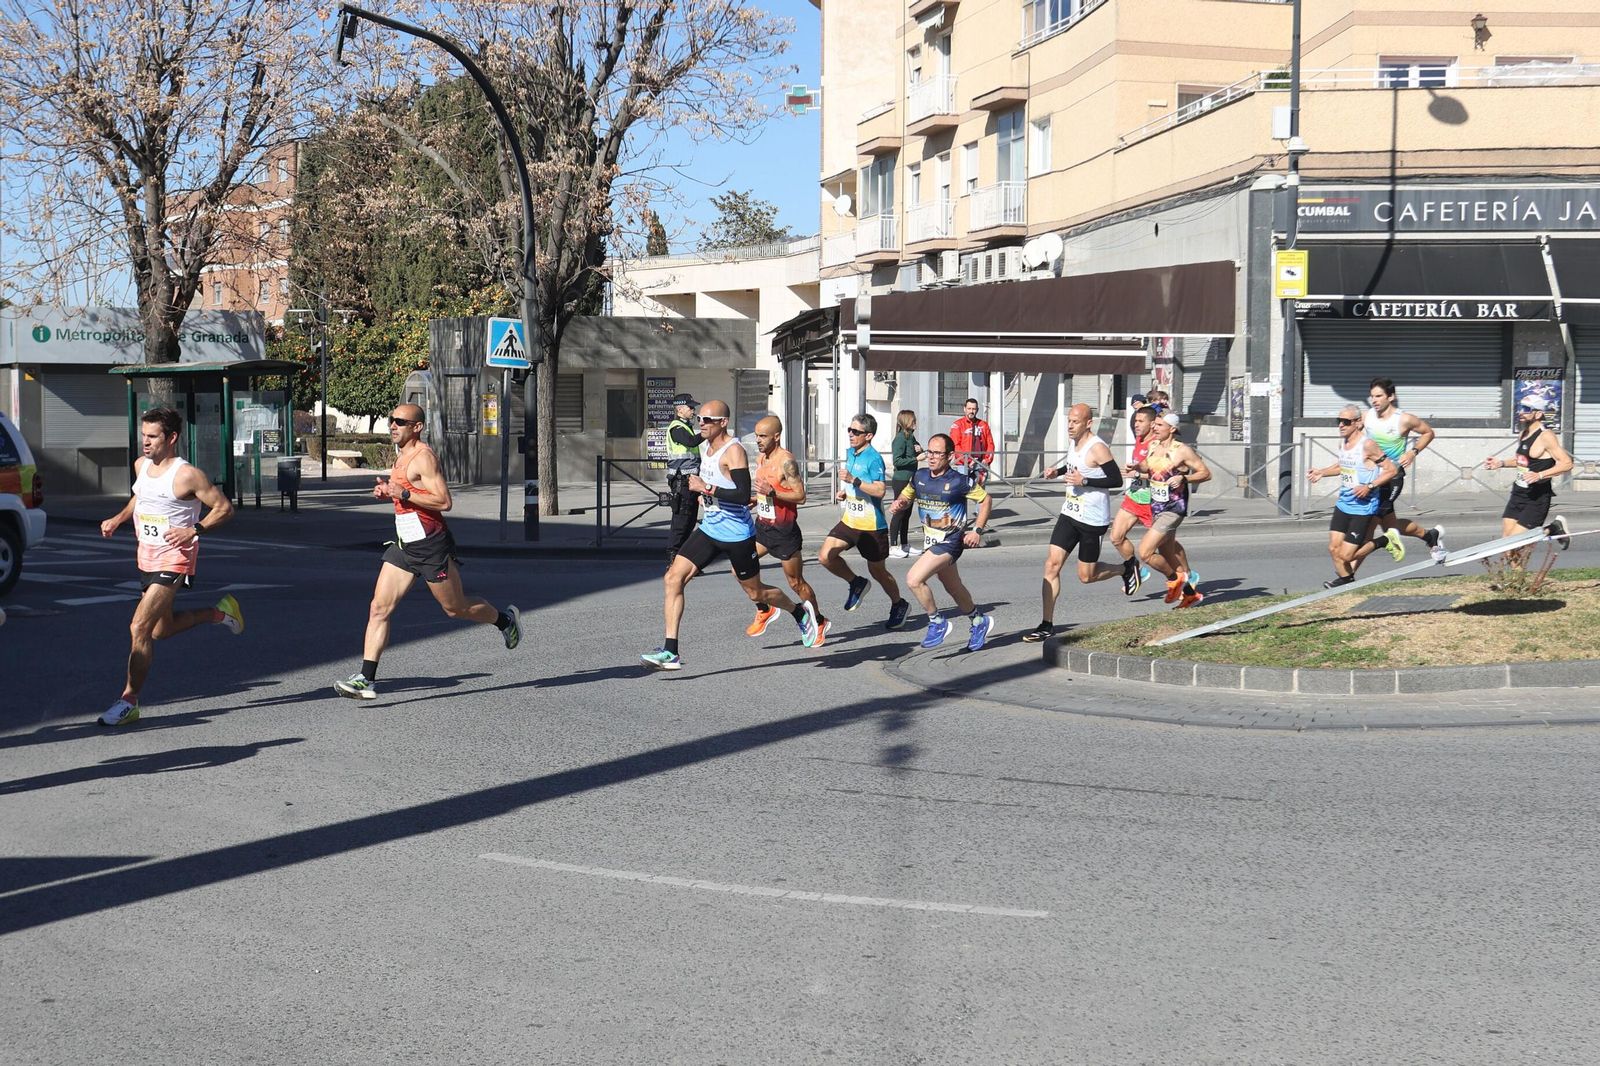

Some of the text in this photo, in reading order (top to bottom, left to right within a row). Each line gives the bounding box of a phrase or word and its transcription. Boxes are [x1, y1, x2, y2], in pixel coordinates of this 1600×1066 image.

[1297, 206, 1352, 217] CUMBAL
[1374, 195, 1597, 222] CAFETERÍA JA
[1352, 300, 1520, 318] CAFETERÍA BAR
[56, 328, 145, 343] Metropolita
[191, 330, 250, 344] Granada
[1515, 368, 1562, 378] FREESTYLE
[144, 524, 159, 537] 53
